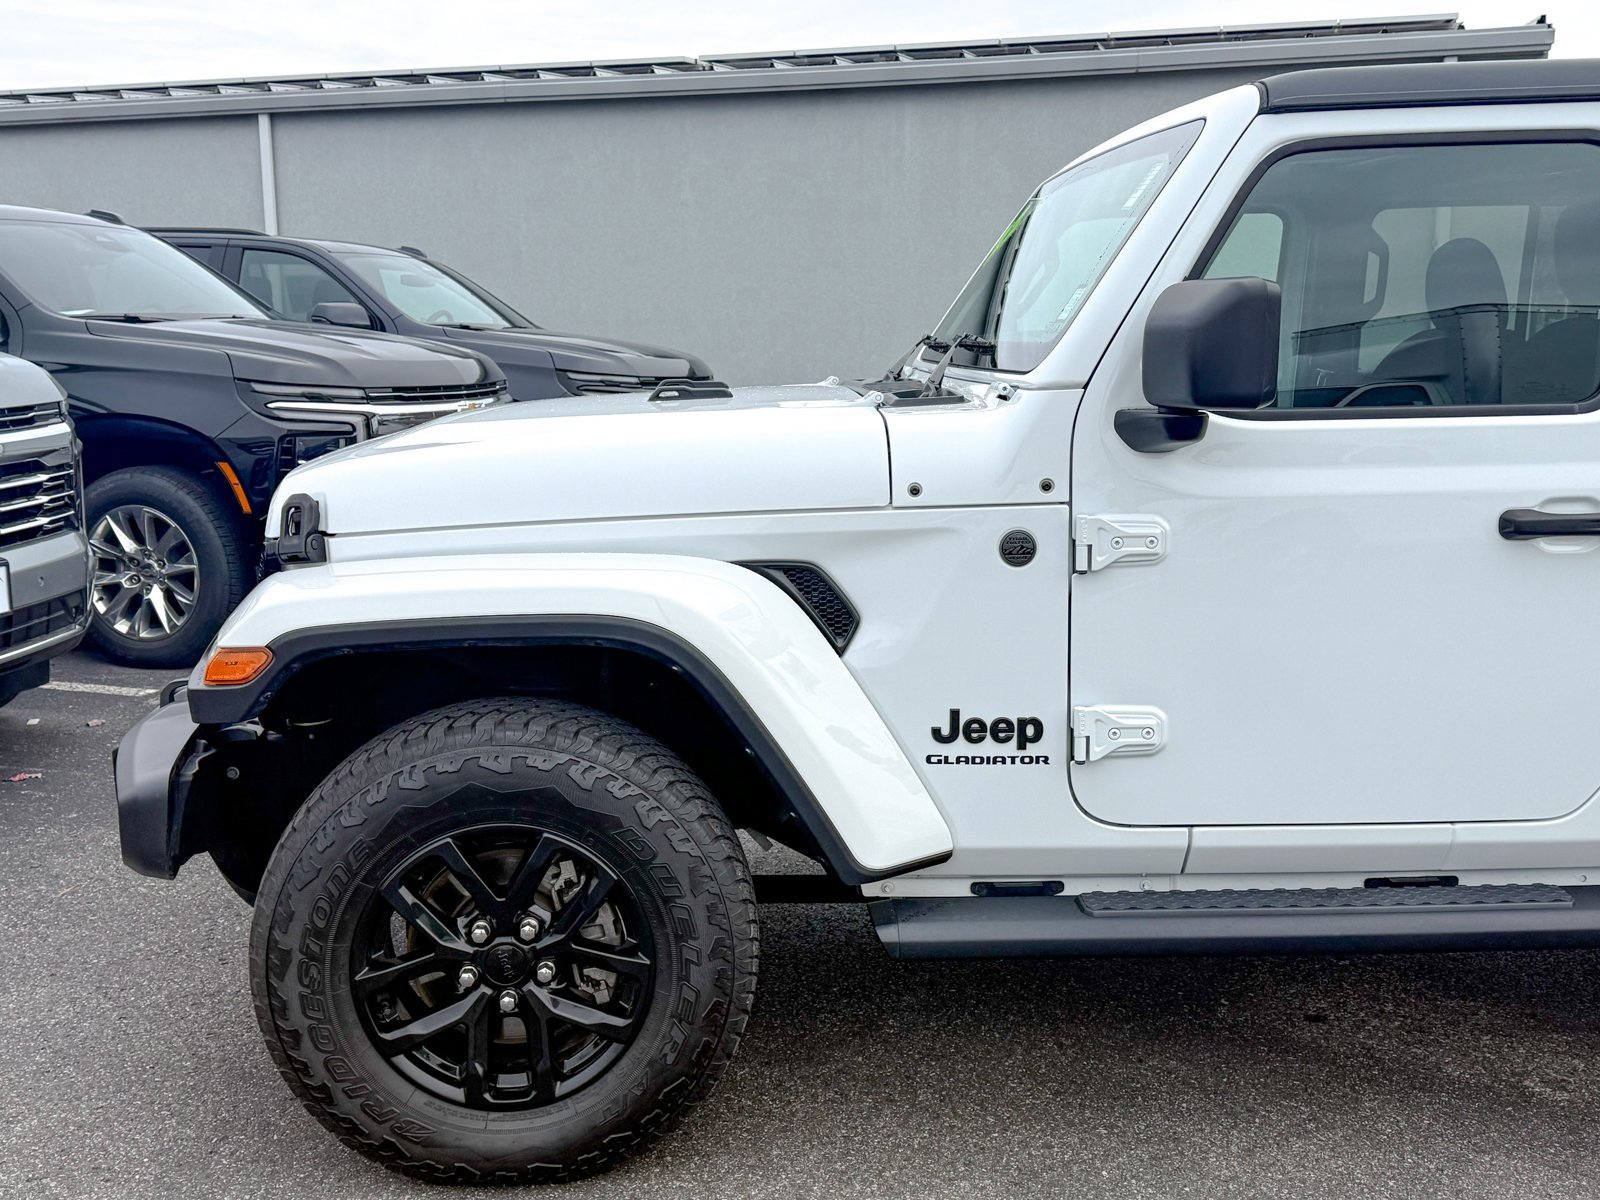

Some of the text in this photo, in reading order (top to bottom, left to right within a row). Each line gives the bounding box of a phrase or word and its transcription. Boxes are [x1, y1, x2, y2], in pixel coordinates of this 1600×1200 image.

[925, 754, 1050, 765] GLADIATOR
[931, 708, 1044, 750] Jeep
[296, 834, 437, 1145] BRIDGESTONE
[612, 827, 702, 1066] DUELLER
